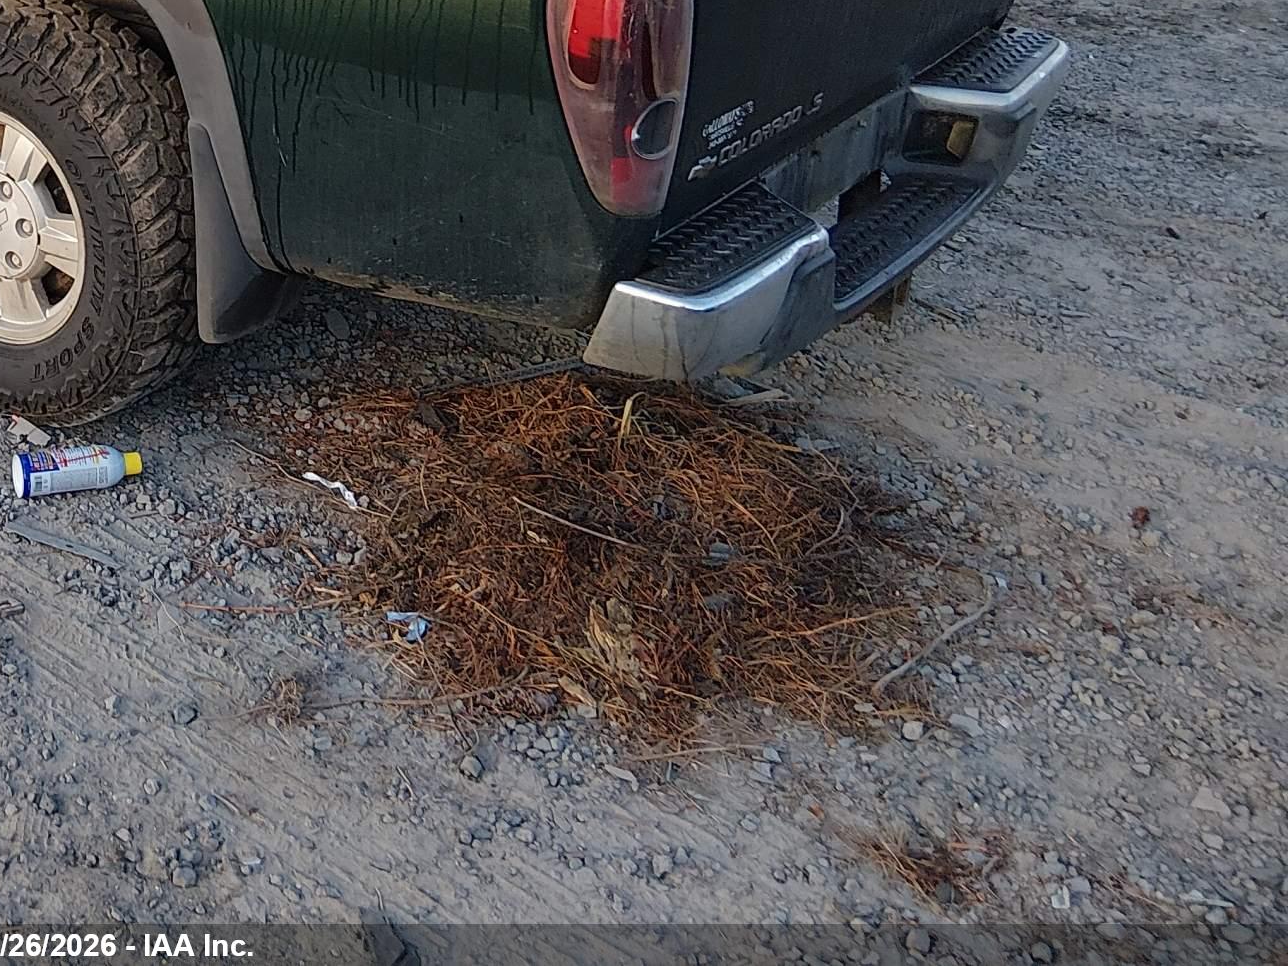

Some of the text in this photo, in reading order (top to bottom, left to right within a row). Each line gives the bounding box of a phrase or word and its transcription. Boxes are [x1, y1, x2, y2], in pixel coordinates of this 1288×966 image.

[718, 105, 803, 167] COLORADO
[30, 158, 107, 383] OPTIMUM SPORT
